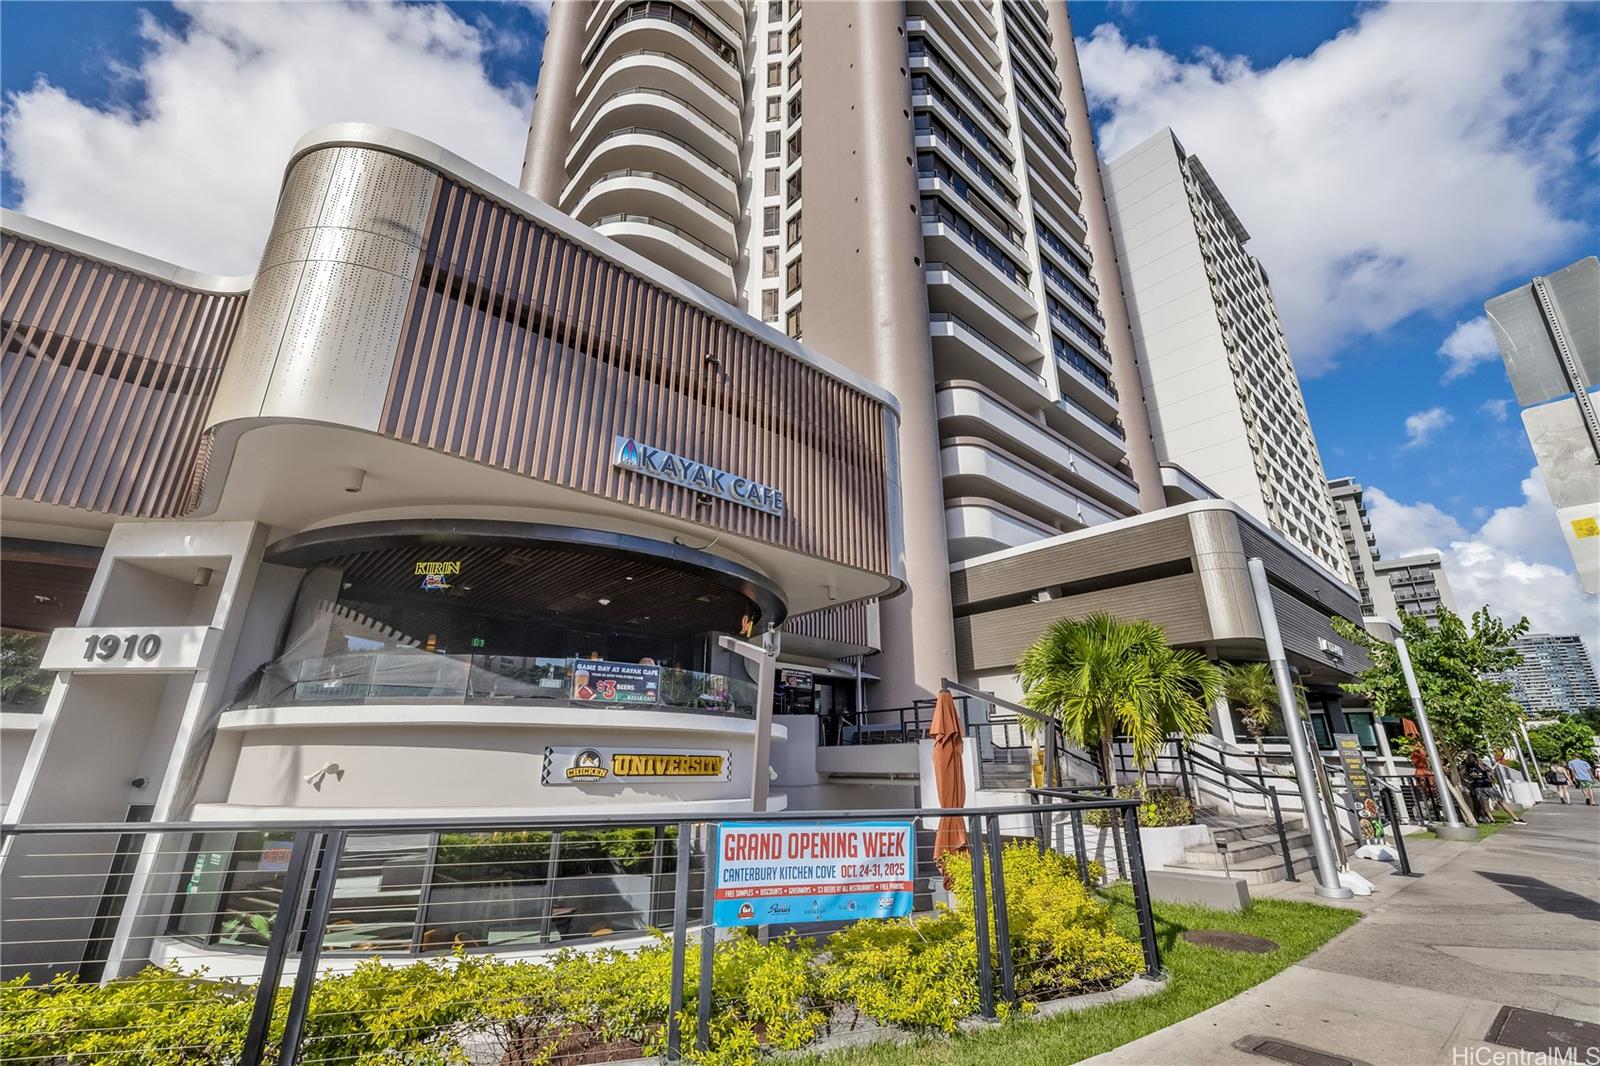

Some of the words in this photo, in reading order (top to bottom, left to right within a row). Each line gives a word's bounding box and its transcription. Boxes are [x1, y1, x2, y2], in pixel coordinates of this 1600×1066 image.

[640, 446, 726, 493] KAYAK
[731, 478, 783, 511] CAFE
[415, 561, 461, 575] KIRIN
[83, 634, 162, 661] 1910
[577, 663, 596, 671] GAME
[596, 680, 616, 699] $3
[568, 767, 607, 778] CHICKEN
[614, 755, 724, 775] UNIVERSITY
[724, 832, 783, 861] GRAND
[788, 831, 858, 859] OPENING
[862, 831, 905, 858] WEEK
[723, 866, 777, 882] CANTERBURY
[779, 865, 814, 880] KITCHEN
[815, 865, 836, 879] COVE
[841, 864, 857, 878] OCT.
[859, 863, 883, 878] 24-31,
[884, 862, 905, 876] 2025
[725, 889, 735, 897] FREE
[736, 888, 754, 897] SAMPLES
[824, 885, 837, 893] BEERS
